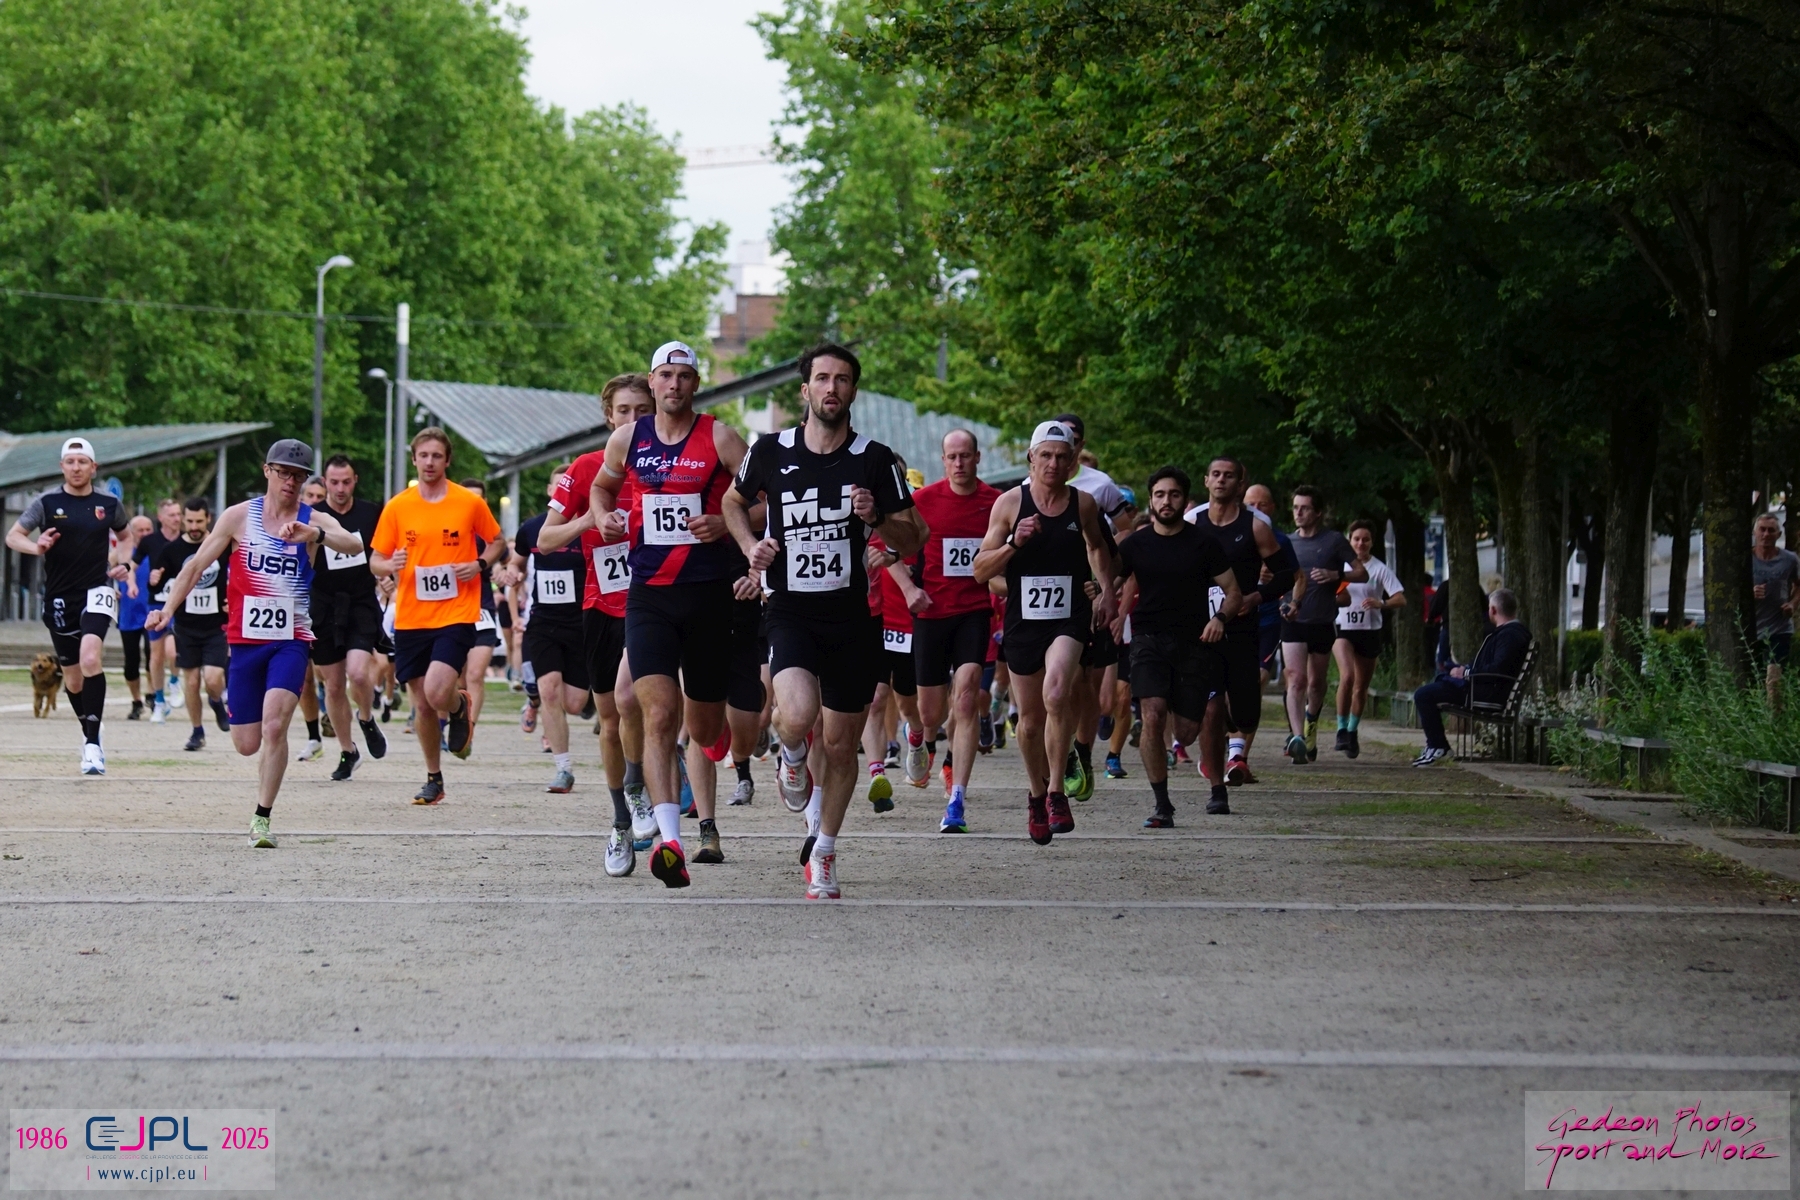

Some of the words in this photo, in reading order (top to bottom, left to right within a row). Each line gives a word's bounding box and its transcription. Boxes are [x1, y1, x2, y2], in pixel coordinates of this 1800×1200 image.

[636, 457, 661, 468] RFC
[672, 456, 706, 469] Liège
[781, 484, 852, 528] MJ
[652, 507, 691, 532] 153
[784, 521, 850, 547] SPORT
[247, 551, 299, 577] USA
[795, 553, 843, 579] 254
[422, 573, 450, 592] 184
[544, 580, 566, 595] 119
[194, 595, 210, 607] 117
[1028, 586, 1065, 609] 272
[249, 607, 287, 629] 229
[1346, 611, 1365, 623] 197
